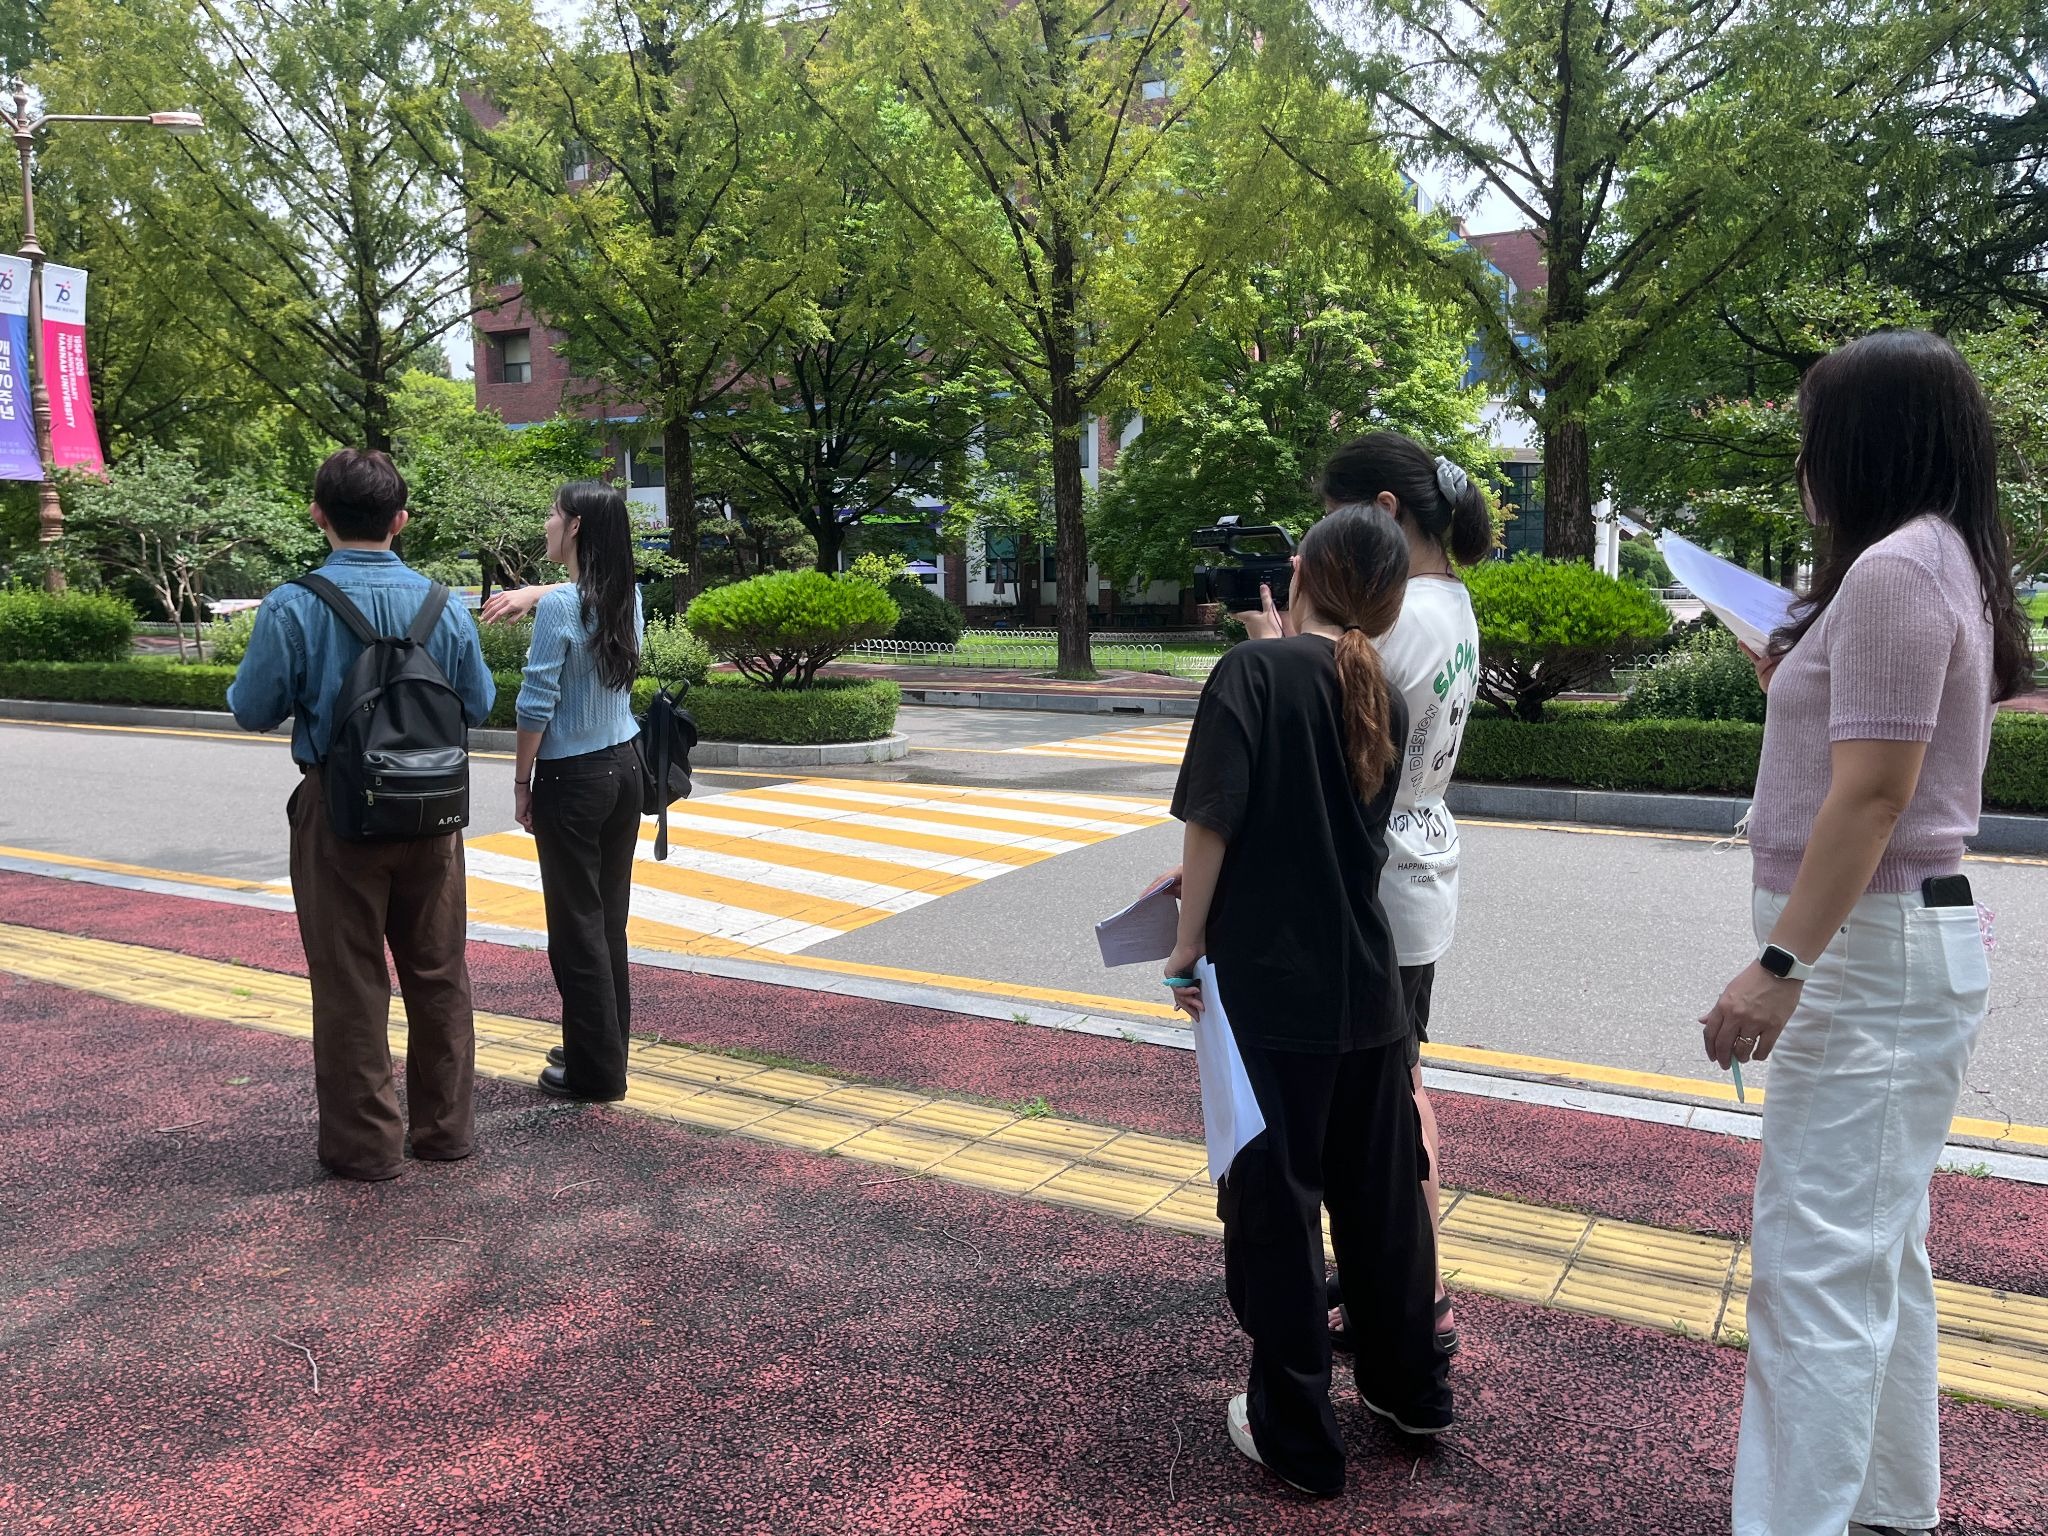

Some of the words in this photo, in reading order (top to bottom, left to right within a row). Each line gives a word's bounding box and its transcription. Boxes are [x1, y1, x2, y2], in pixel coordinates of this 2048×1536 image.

[58, 332, 68, 373] HANNAM
[61, 374, 76, 428] UNIVERSITY
[1409, 703, 1439, 771] DESIGN
[1397, 862, 1435, 871] HAPPINESS
